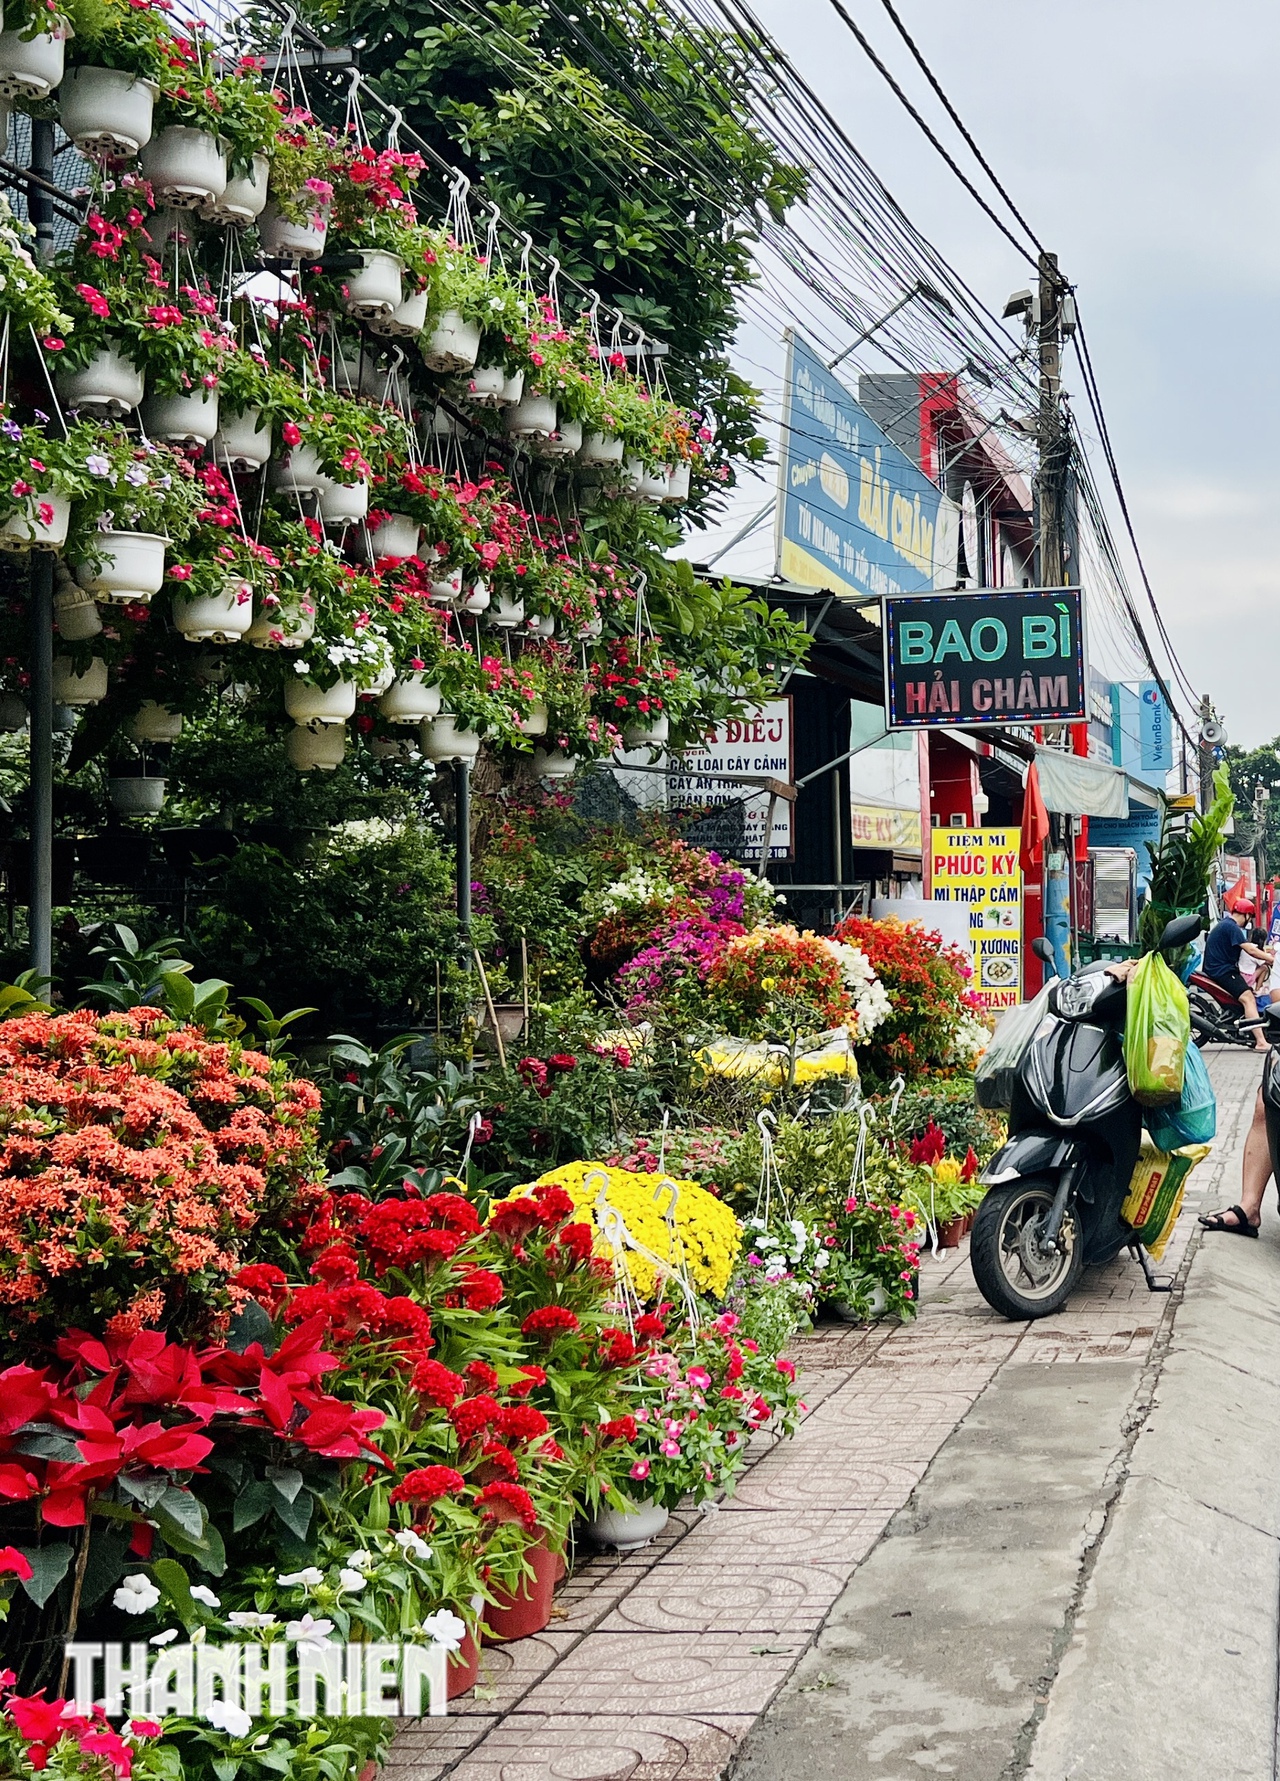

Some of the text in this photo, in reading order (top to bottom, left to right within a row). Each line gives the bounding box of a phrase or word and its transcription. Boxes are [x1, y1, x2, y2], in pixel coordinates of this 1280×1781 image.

[899, 602, 1072, 665] BAO BÌ
[905, 670, 961, 714] HẢI
[971, 669, 1070, 712] CHÂM
[697, 758, 723, 773] LOẠI
[727, 755, 751, 771] CÂY
[754, 754, 787, 771] CẢNH
[947, 831, 1006, 849] TIỆM MÌ
[934, 850, 1017, 877] PHÚC KÝ
[934, 880, 1018, 906] MÌ THẬP CẨM
[980, 938, 1019, 955] XƯƠNG
